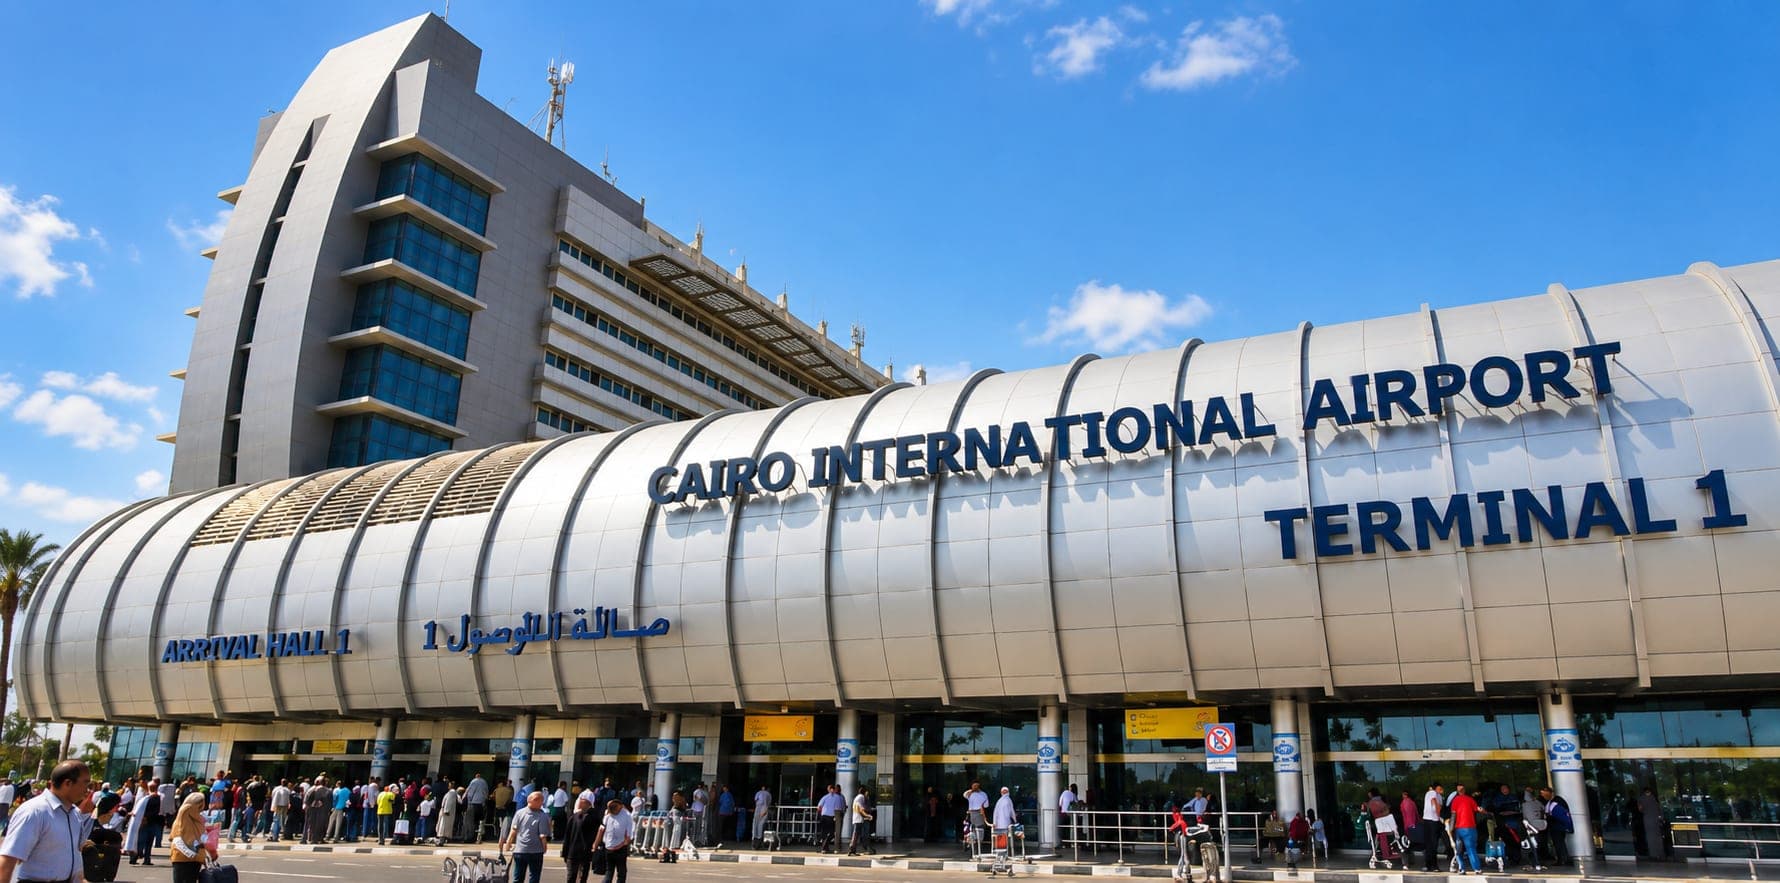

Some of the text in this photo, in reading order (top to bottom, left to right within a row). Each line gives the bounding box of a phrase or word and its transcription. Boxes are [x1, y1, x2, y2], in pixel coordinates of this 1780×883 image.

[648, 341, 1621, 504] CAIRO INTERNATIONAL AIRPORT
[1264, 469, 1748, 560] TERMINAL 1
[161, 628, 352, 663] ARRIVAL HALL 1
[423, 620, 438, 650] 1
